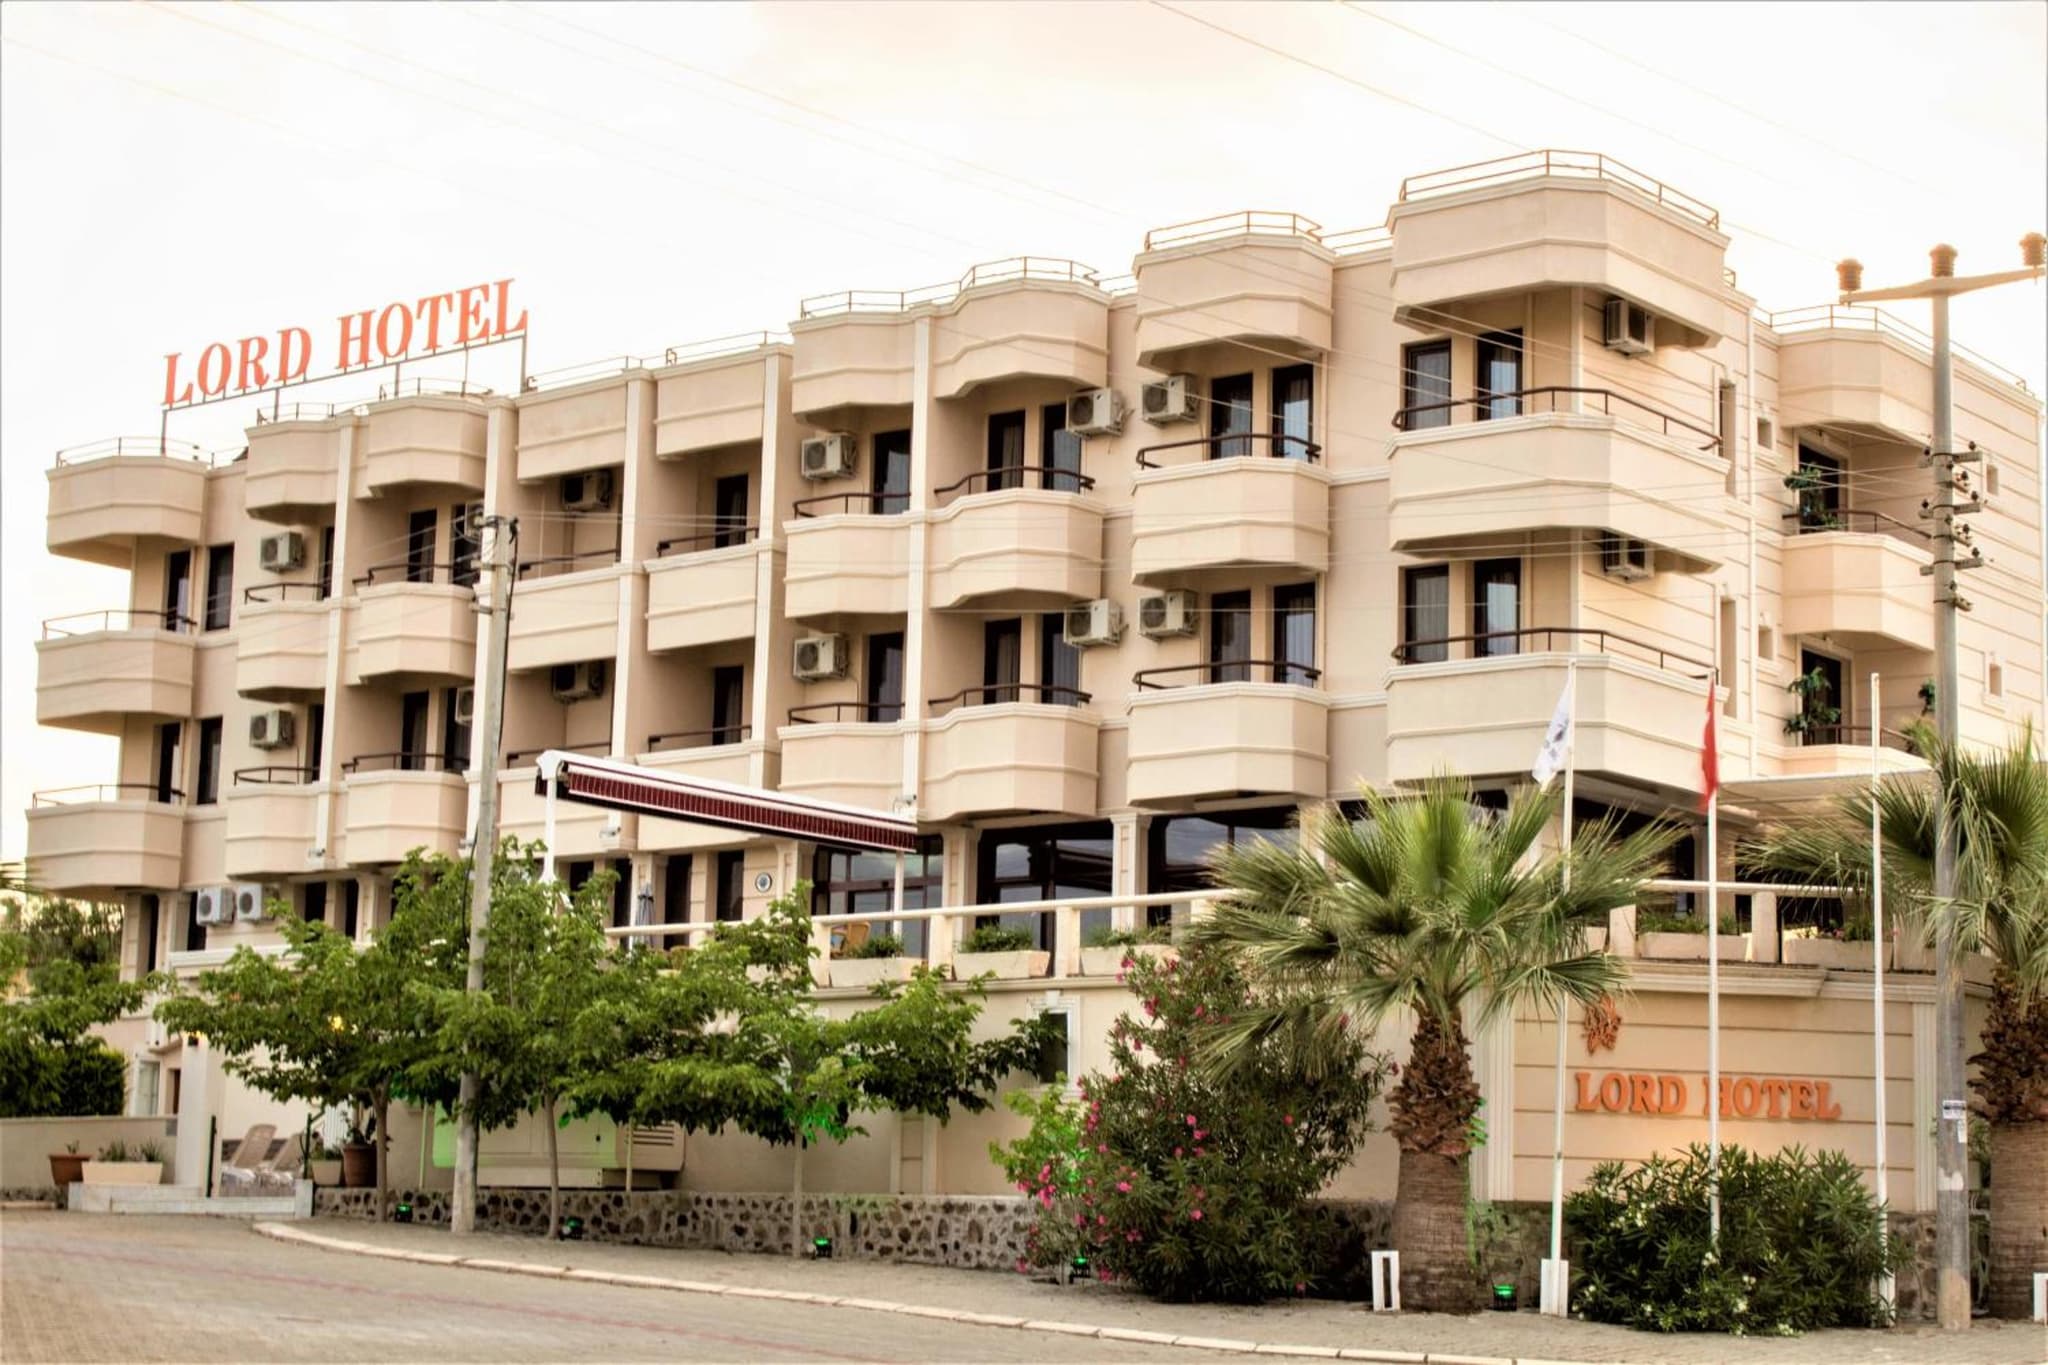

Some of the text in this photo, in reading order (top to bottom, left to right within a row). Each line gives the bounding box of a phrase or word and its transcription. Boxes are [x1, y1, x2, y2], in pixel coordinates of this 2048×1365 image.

[161, 277, 529, 406] LORD HOTEL
[1575, 1071, 1842, 1122] LORD HOTEL
